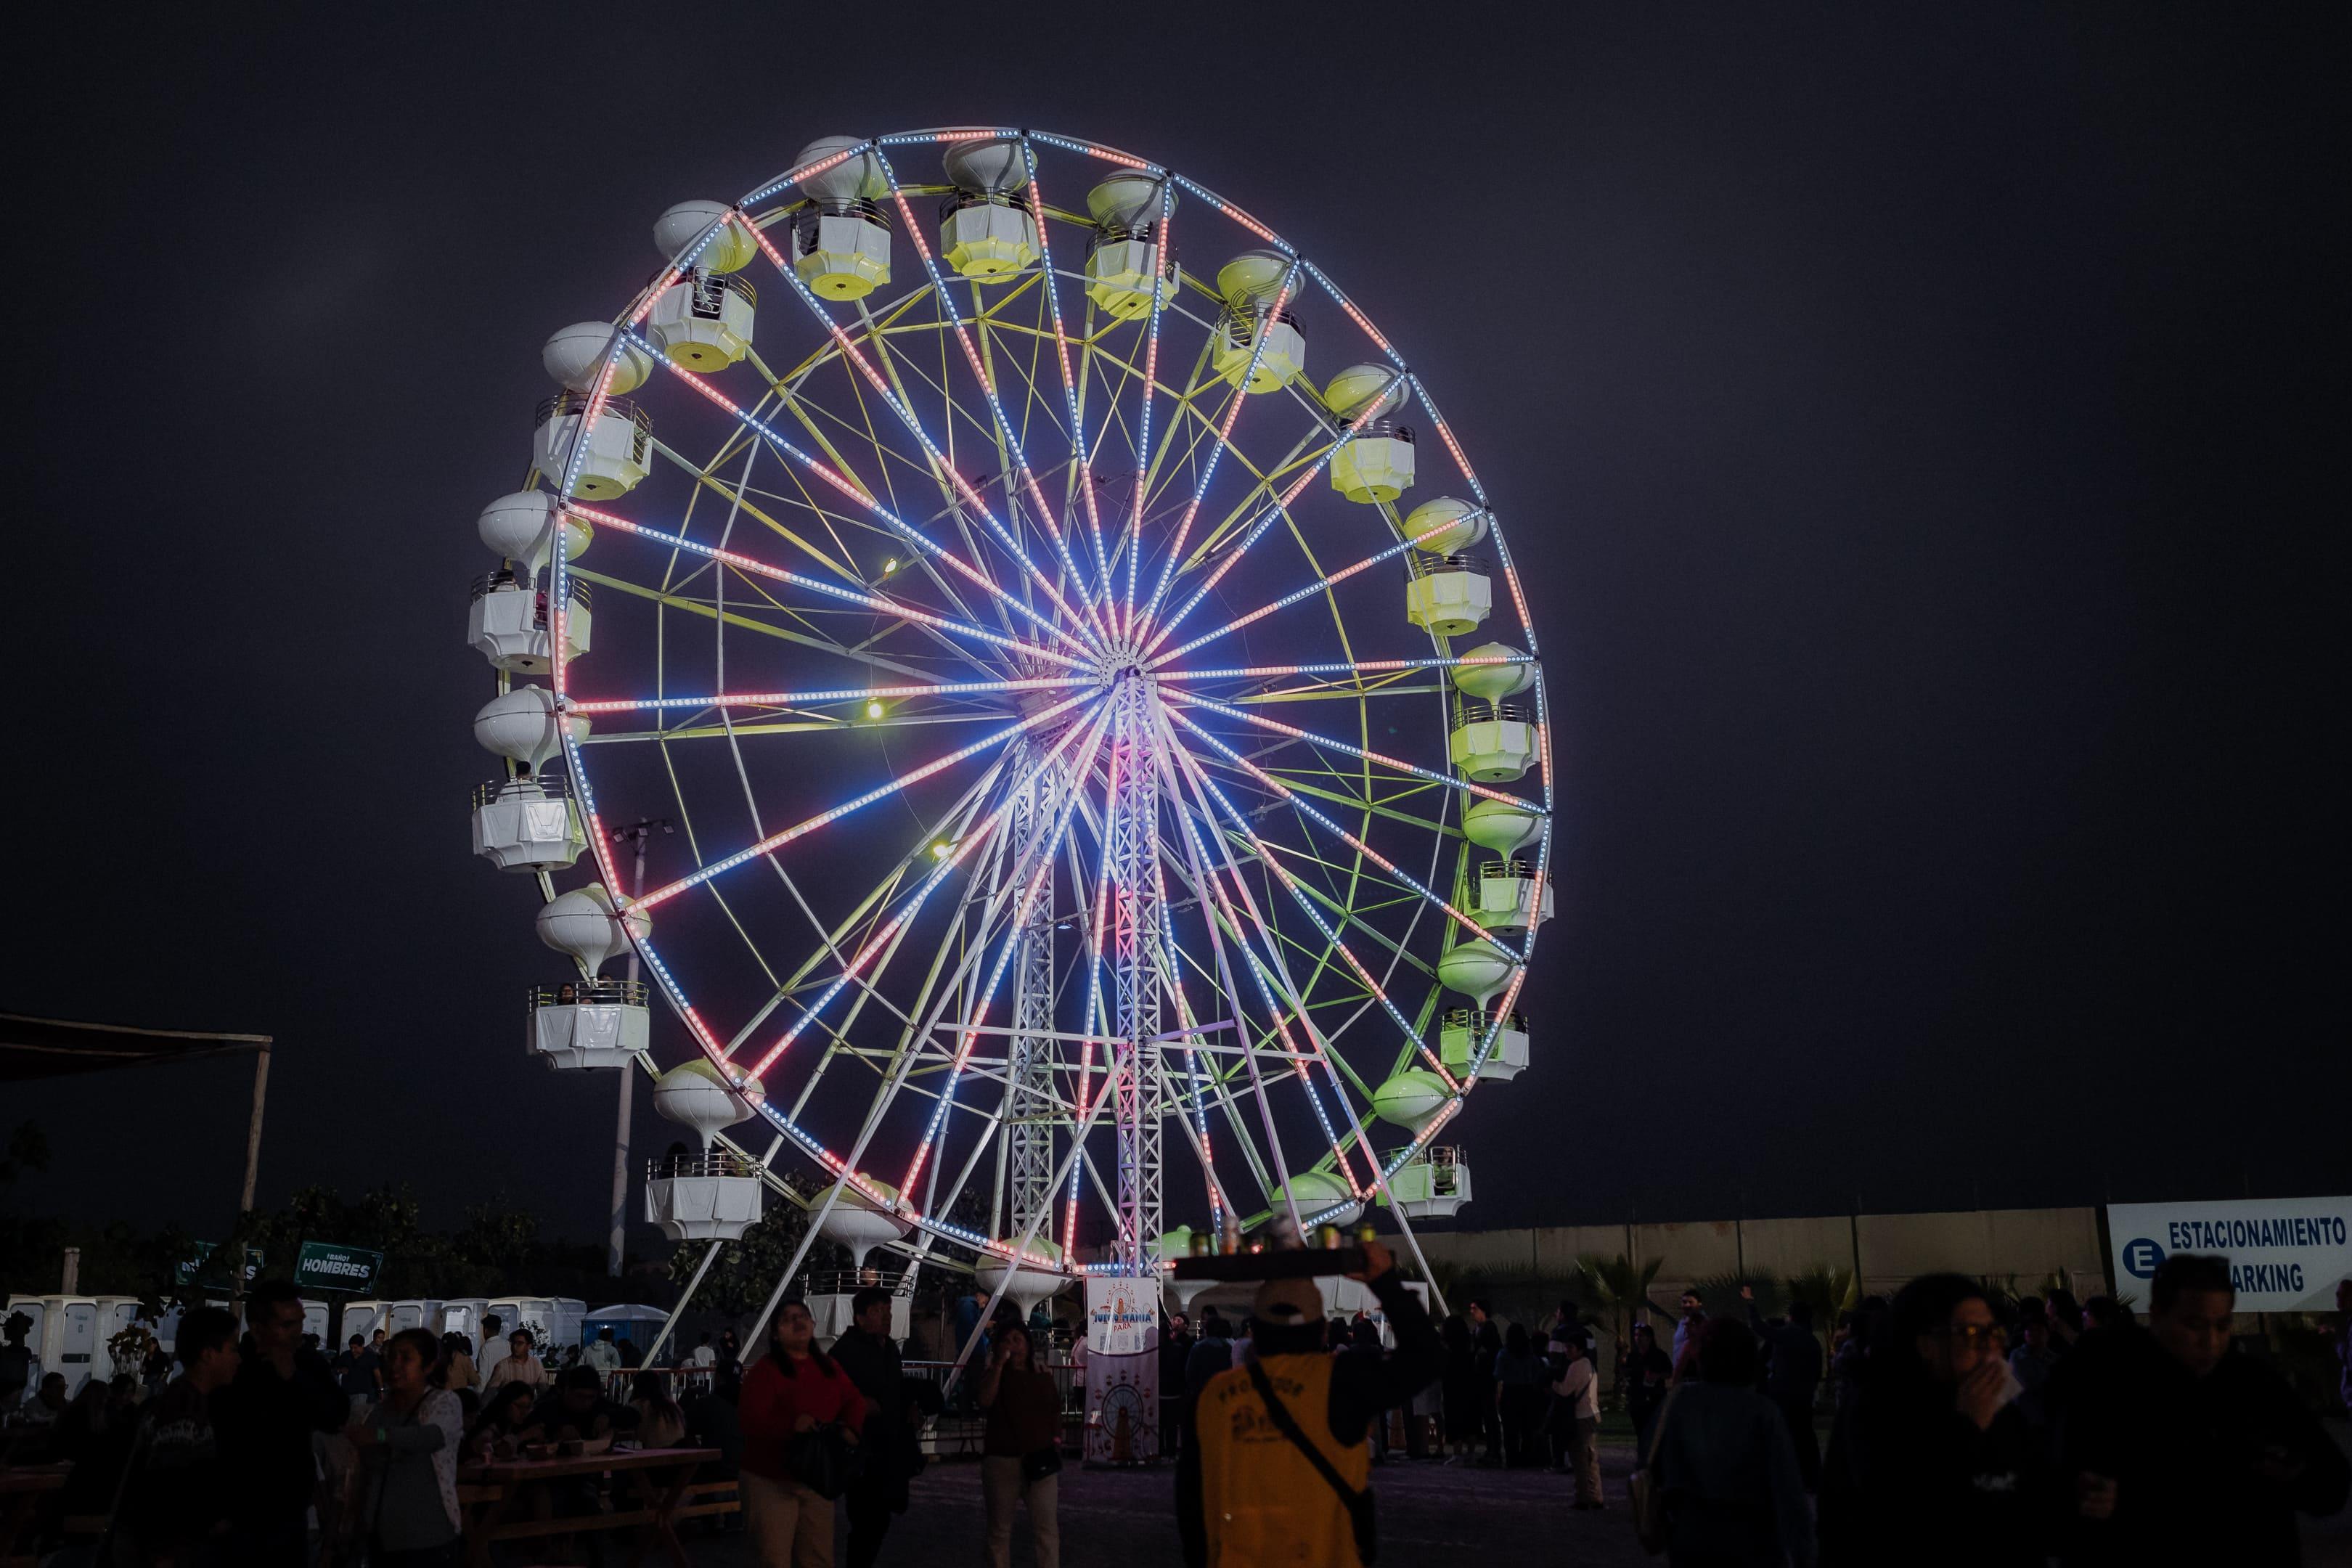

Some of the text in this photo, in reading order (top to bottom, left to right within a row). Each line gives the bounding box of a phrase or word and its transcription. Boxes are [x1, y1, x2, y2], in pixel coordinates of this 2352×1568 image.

[2168, 1217, 2347, 1249] ESTACIONAMIENTO
[302, 1258, 371, 1279] HOMBRES
[2132, 1245, 2156, 1271] E
[2229, 1263, 2304, 1293] ARKING
[1114, 1323, 1132, 1333] PARK
